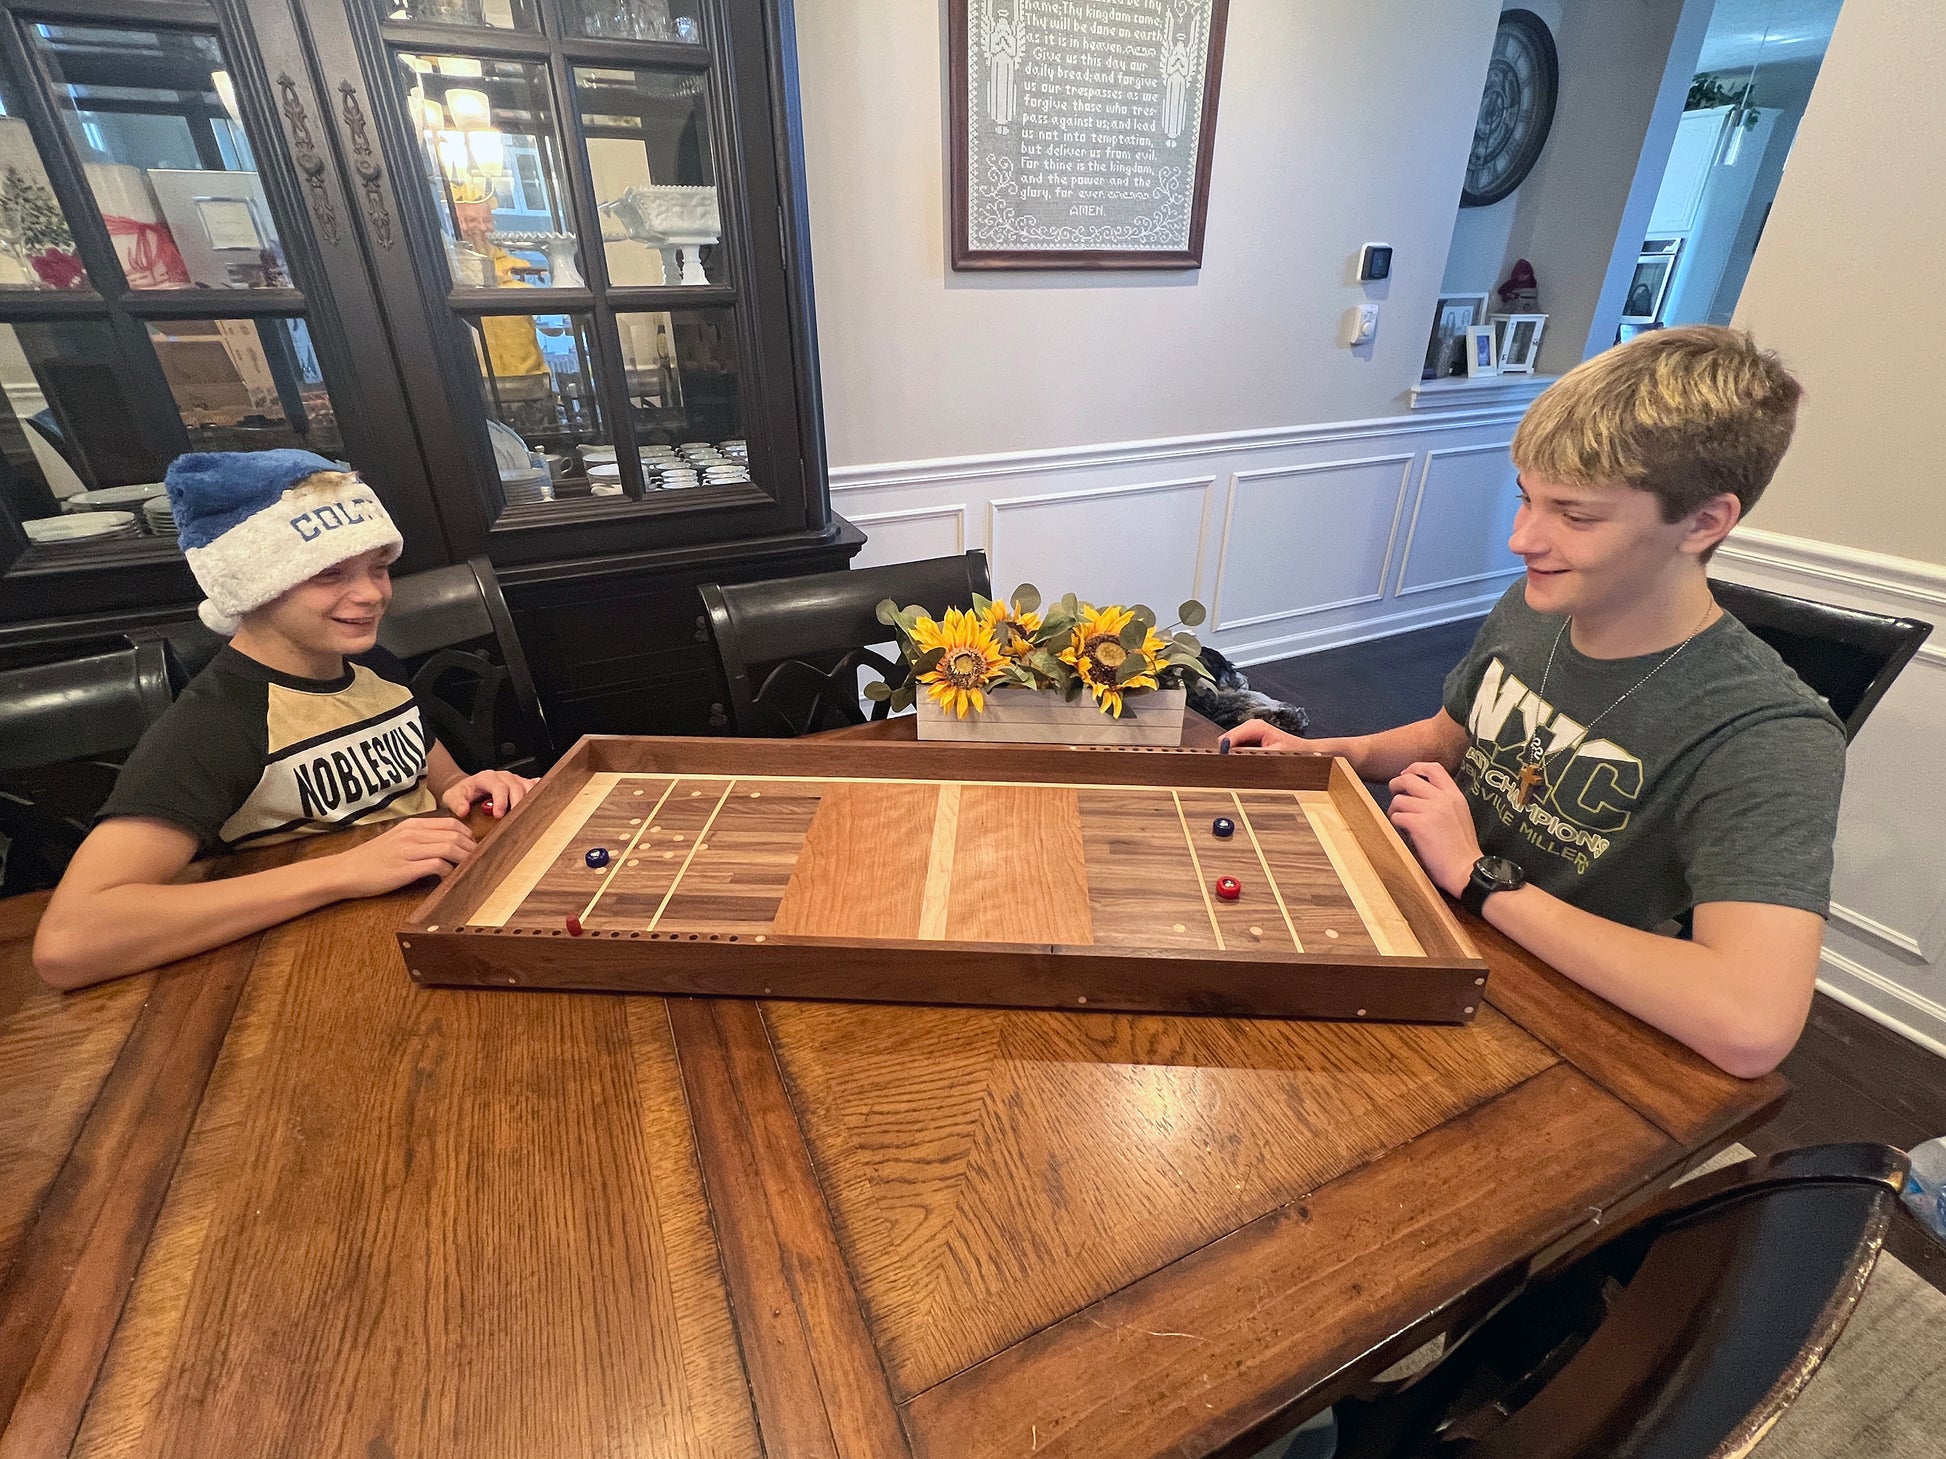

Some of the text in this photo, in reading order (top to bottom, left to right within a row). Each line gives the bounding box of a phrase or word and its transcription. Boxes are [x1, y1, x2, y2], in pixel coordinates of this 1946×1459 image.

[1063, 1, 1083, 20] Thy
[1086, 4, 1131, 24] kingdom
[1025, 12, 1163, 42] Thy will be done on earth
[1026, 31, 1122, 53] as it is in heaven
[1033, 46, 1148, 71] Give us this day our
[1025, 61, 1054, 81] daily
[1093, 70, 1114, 84] and
[1117, 71, 1157, 90] forgive
[1024, 80, 1158, 102] us our trespasses as we
[1024, 94, 1068, 112] forgive
[1072, 98, 1102, 113] those
[1106, 102, 1127, 115] who
[1022, 112, 1048, 126] pass
[1051, 114, 1094, 131] against
[1111, 117, 1130, 131] and
[1134, 118, 1156, 132] lead
[1021, 128, 1034, 139] us
[1038, 130, 1059, 140] not
[1063, 131, 1086, 142] into
[1021, 140, 1042, 155] but
[1046, 143, 1087, 158] deliver
[1090, 149, 1101, 158] us
[1105, 146, 1131, 160] from
[1021, 156, 1040, 169] For
[1043, 158, 1073, 171] thine
[1077, 159, 1084, 171] is
[1087, 159, 1107, 172] the
[1020, 171, 1151, 188] and the power and the
[1055, 186, 1073, 198] for
[290, 498, 384, 542] COLT
